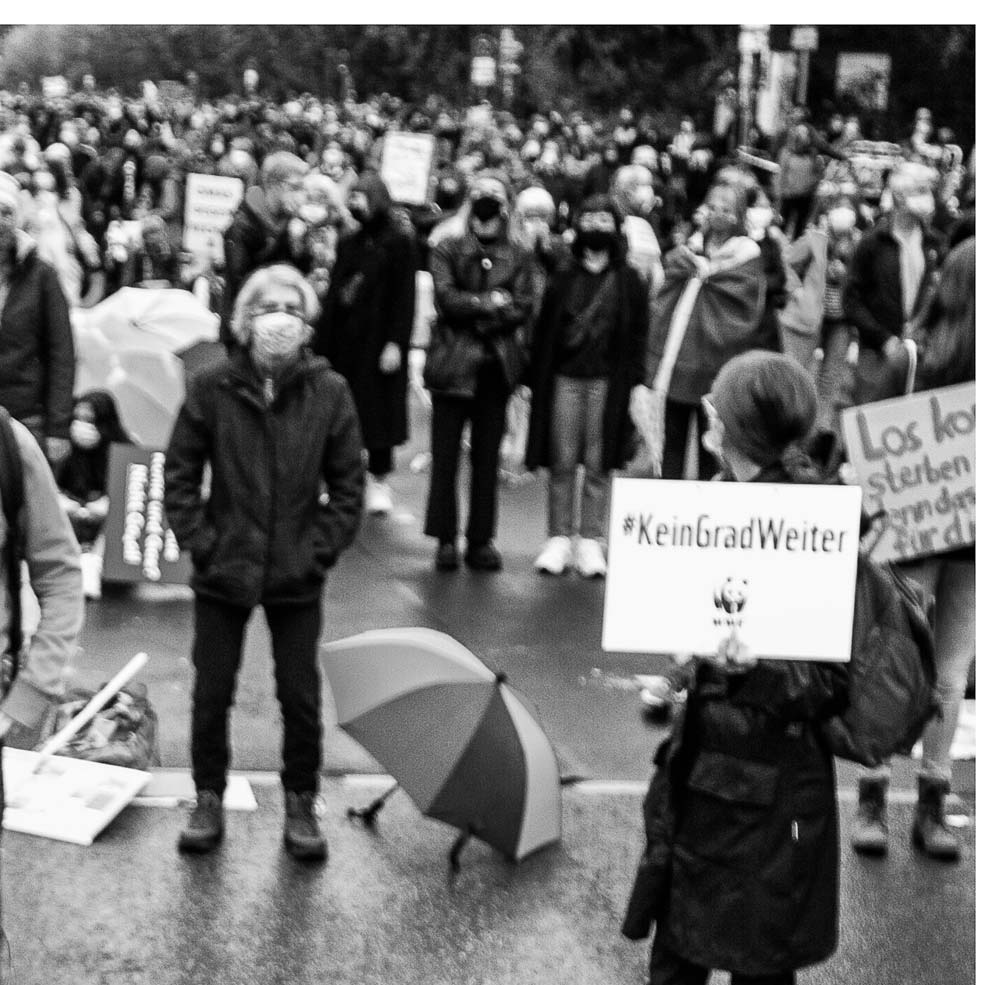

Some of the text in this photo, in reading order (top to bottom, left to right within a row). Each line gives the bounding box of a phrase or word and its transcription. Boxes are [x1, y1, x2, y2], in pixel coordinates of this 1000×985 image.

[855, 396, 975, 462] Los ko
[868, 453, 971, 496] sterben
[622, 513, 848, 553] #KeinGradWeiter
